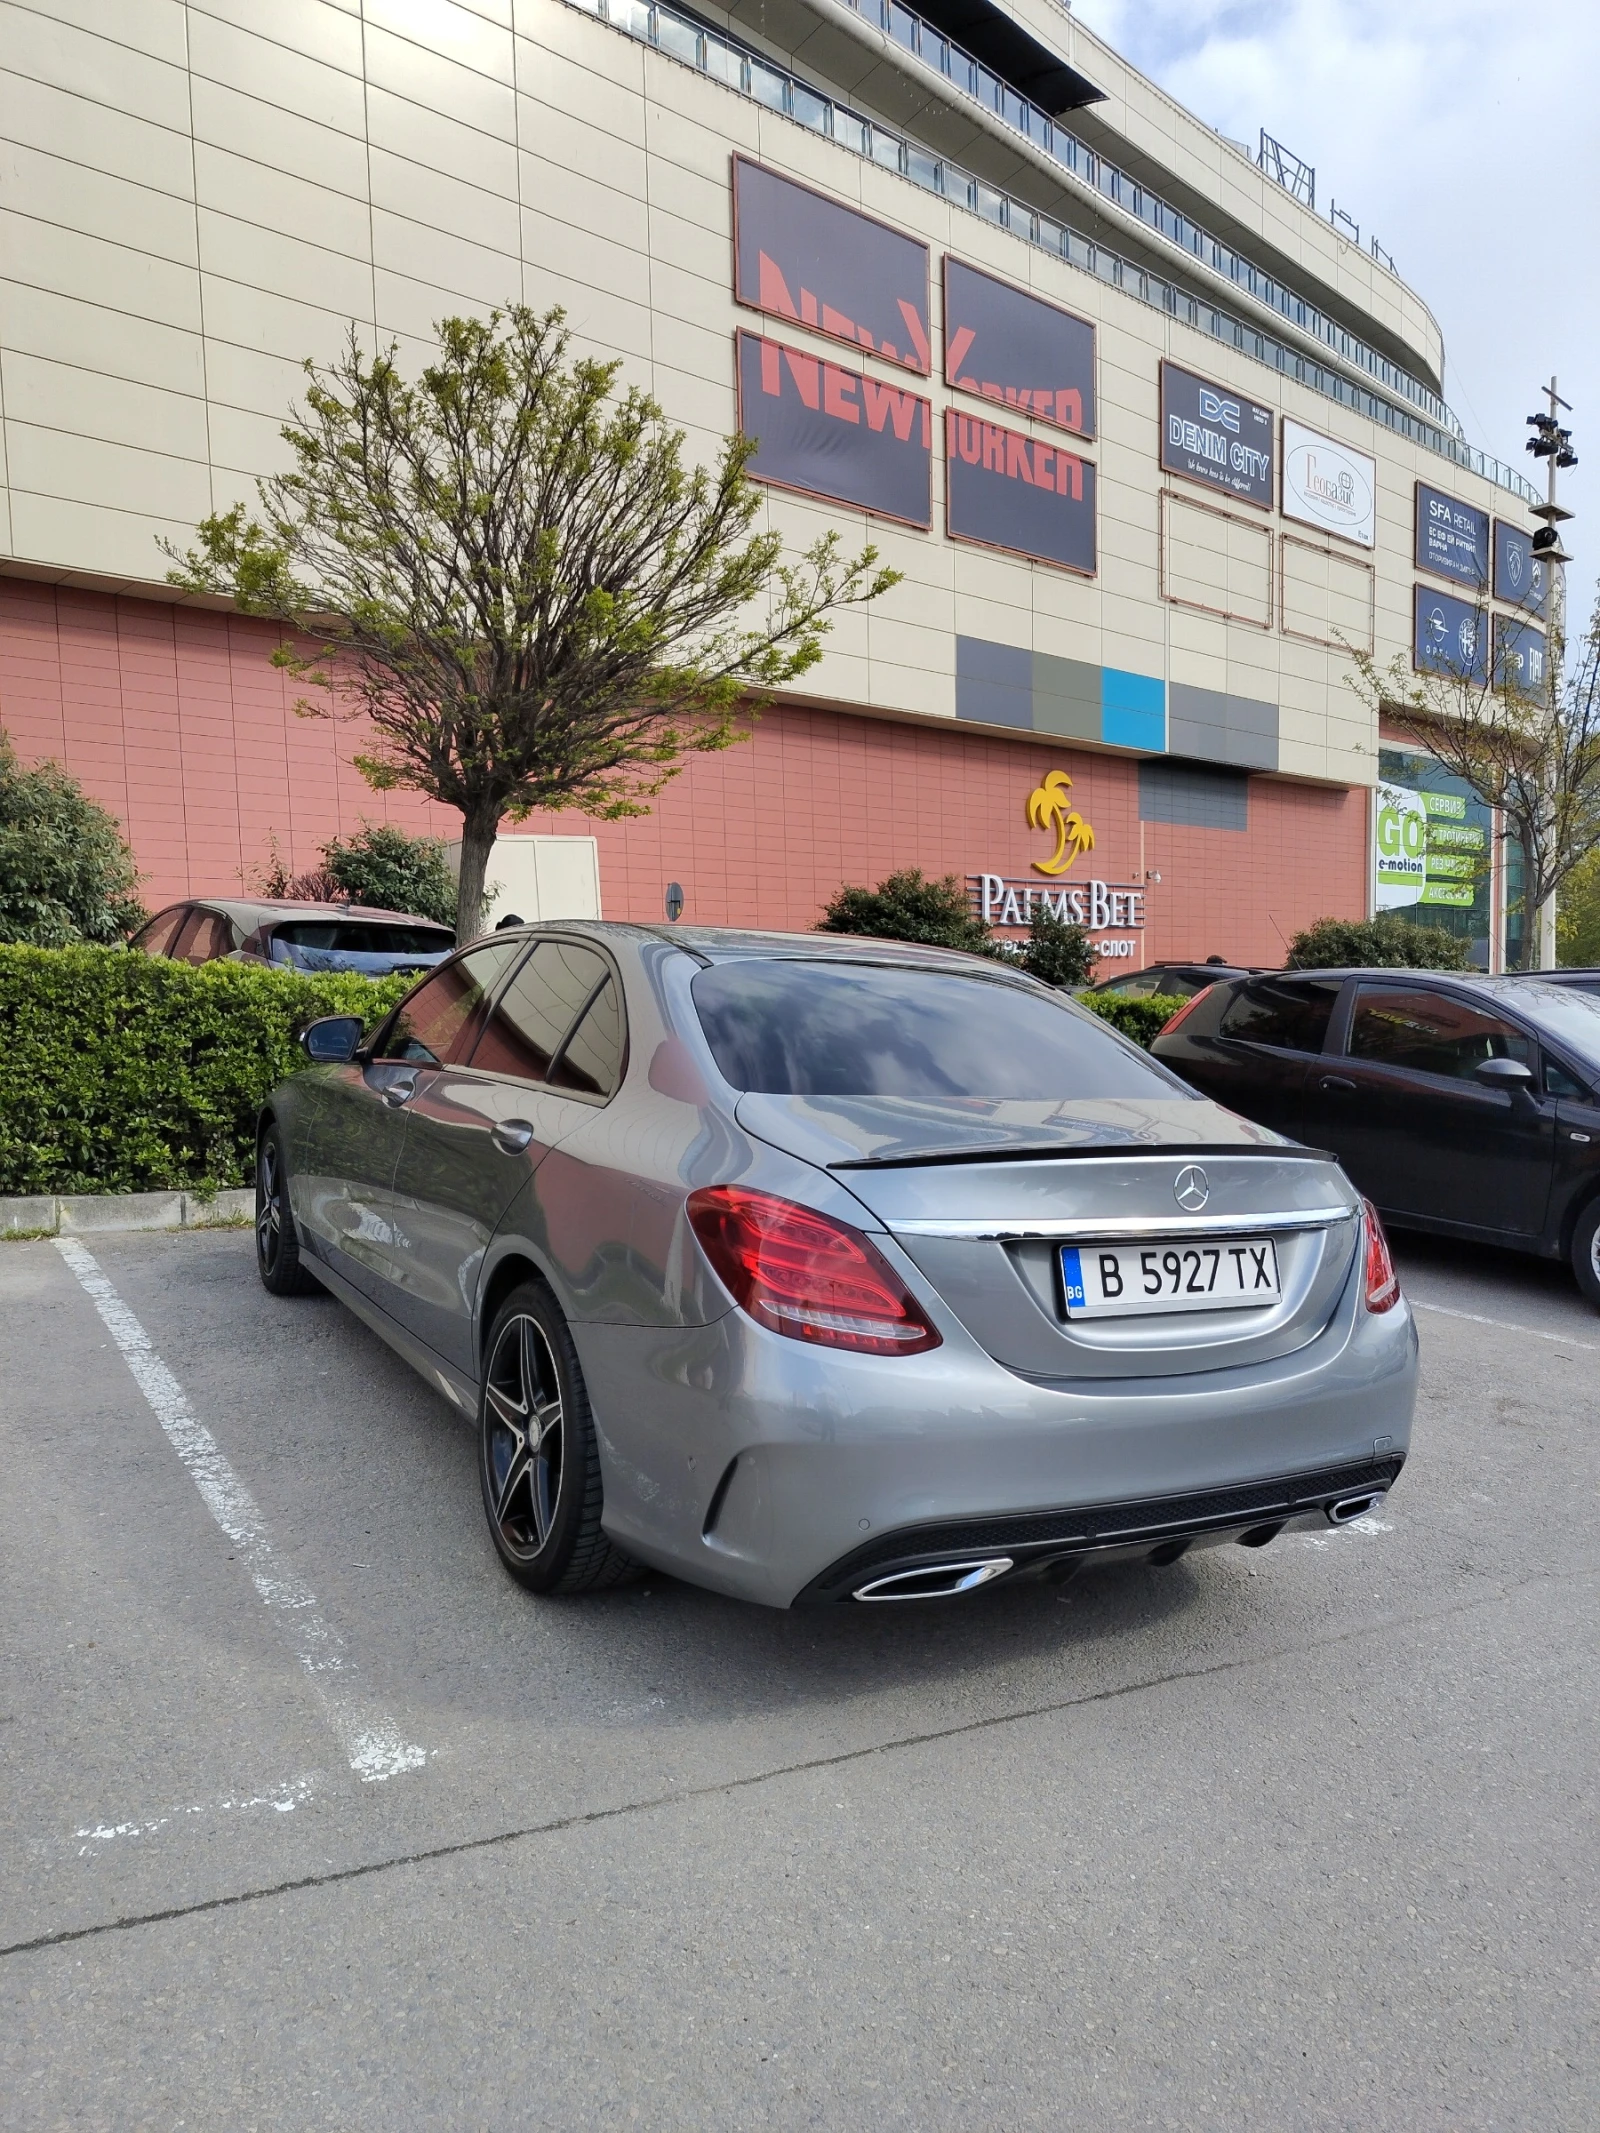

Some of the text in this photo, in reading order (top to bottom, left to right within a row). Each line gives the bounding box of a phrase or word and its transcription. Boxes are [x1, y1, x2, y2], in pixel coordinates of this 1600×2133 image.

[1169, 414, 1270, 482] DENIM CITY
[1429, 500, 1476, 535] SFA RETAIL
[1529, 647, 1542, 684] FIAT
[1429, 797, 1461, 815] СЕРВИЗ
[1378, 806, 1424, 859] GO
[1378, 858, 1423, 873] e-motion
[981, 874, 1141, 929] PALMS BET
[1098, 1247, 1272, 1298] B 5927 TX
[1066, 1286, 1083, 1299] BG
